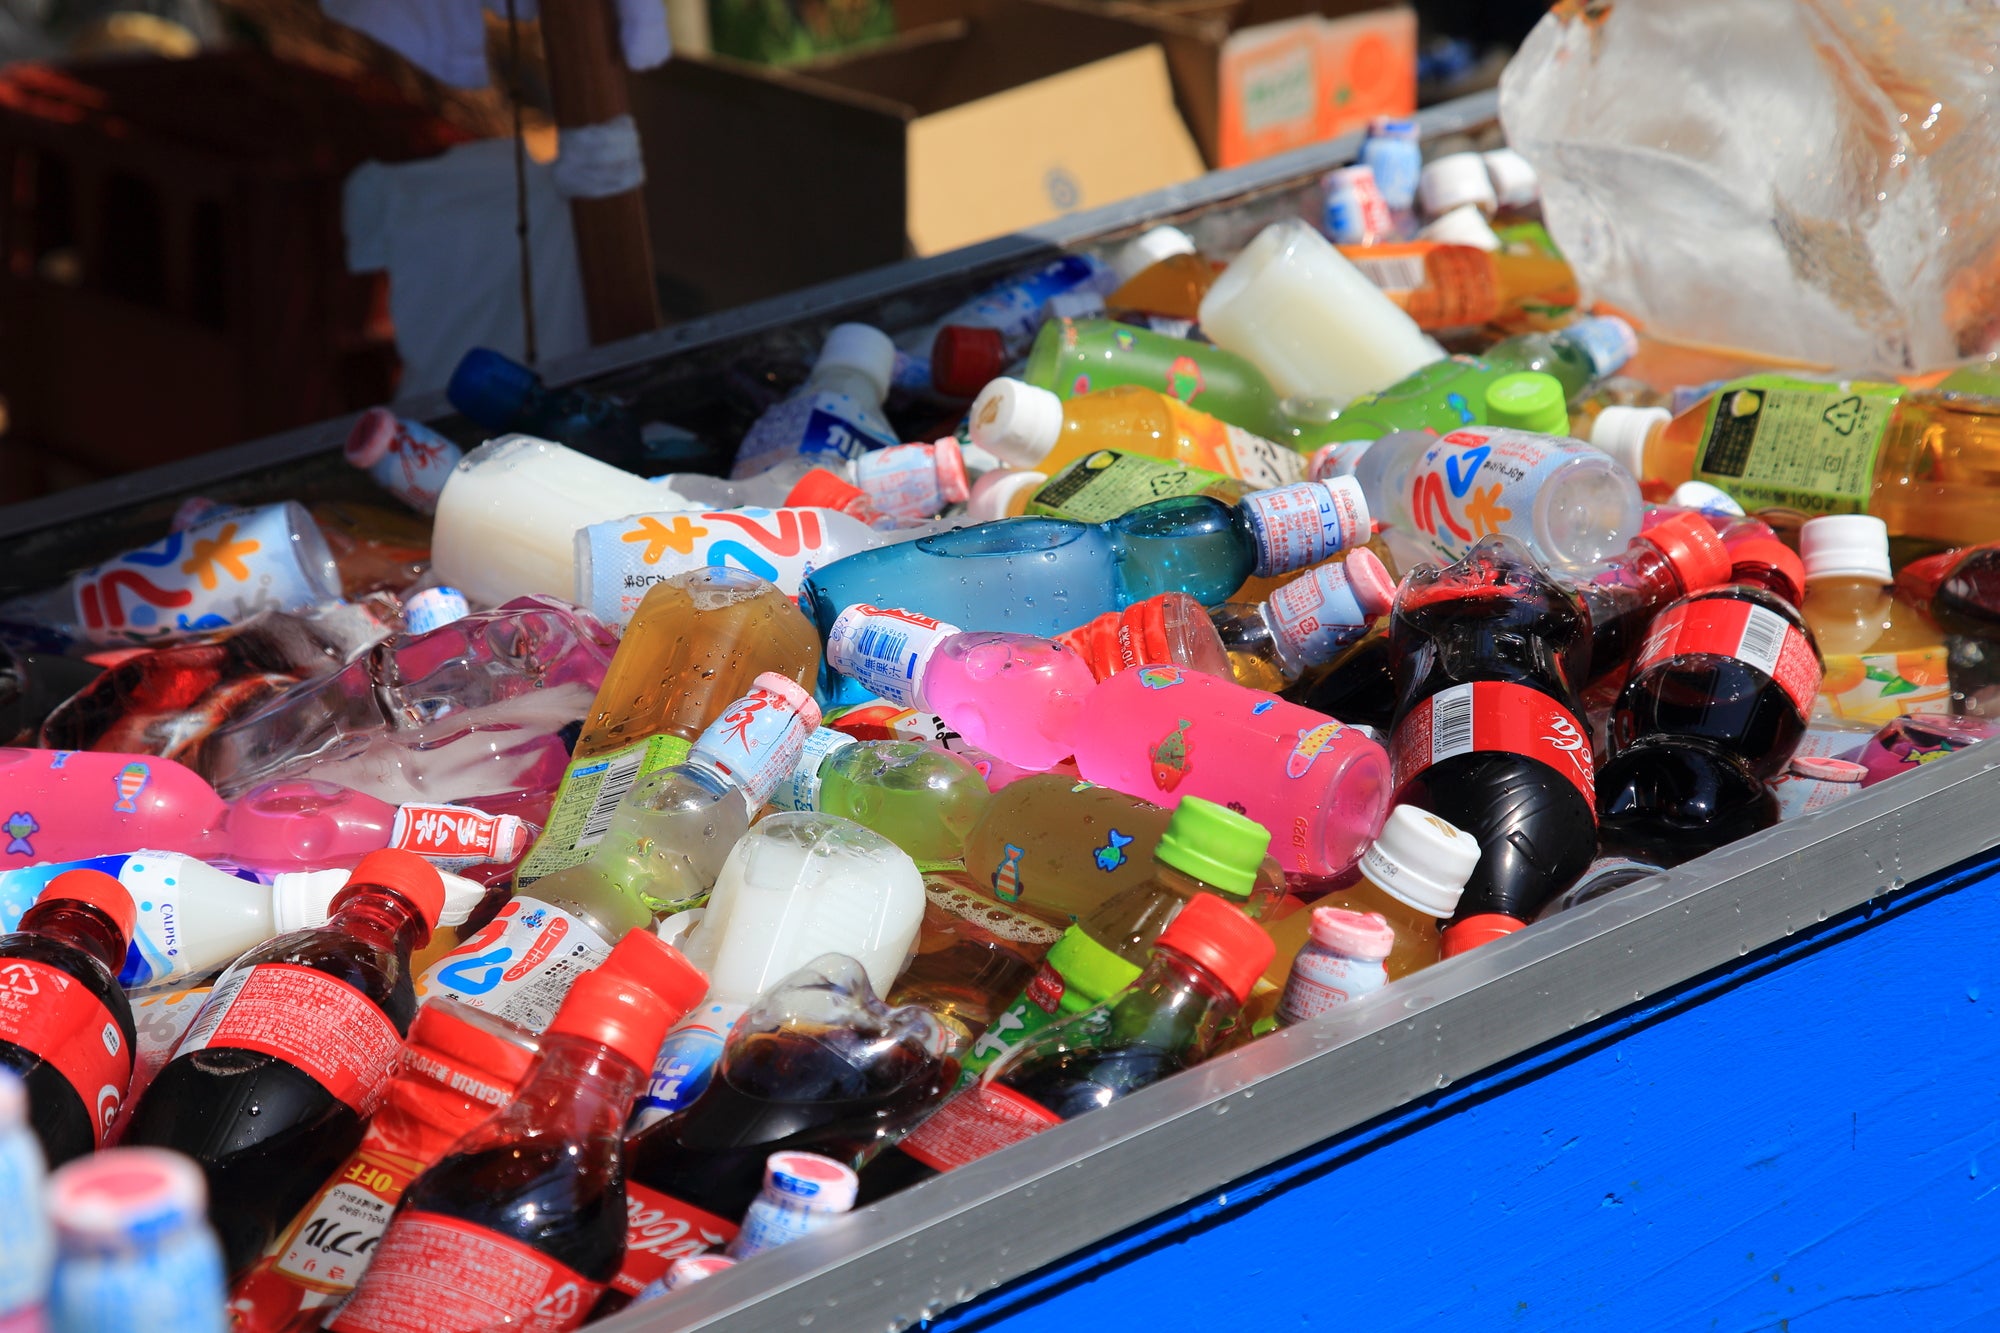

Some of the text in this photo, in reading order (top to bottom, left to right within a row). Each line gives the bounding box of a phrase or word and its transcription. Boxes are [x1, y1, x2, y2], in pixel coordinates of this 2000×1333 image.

[862, 658, 902, 678] 無果汁
[415, 812, 478, 848] ラムネ
[1292, 816, 1309, 849] 1929
[159, 903, 175, 947] CALPIS
